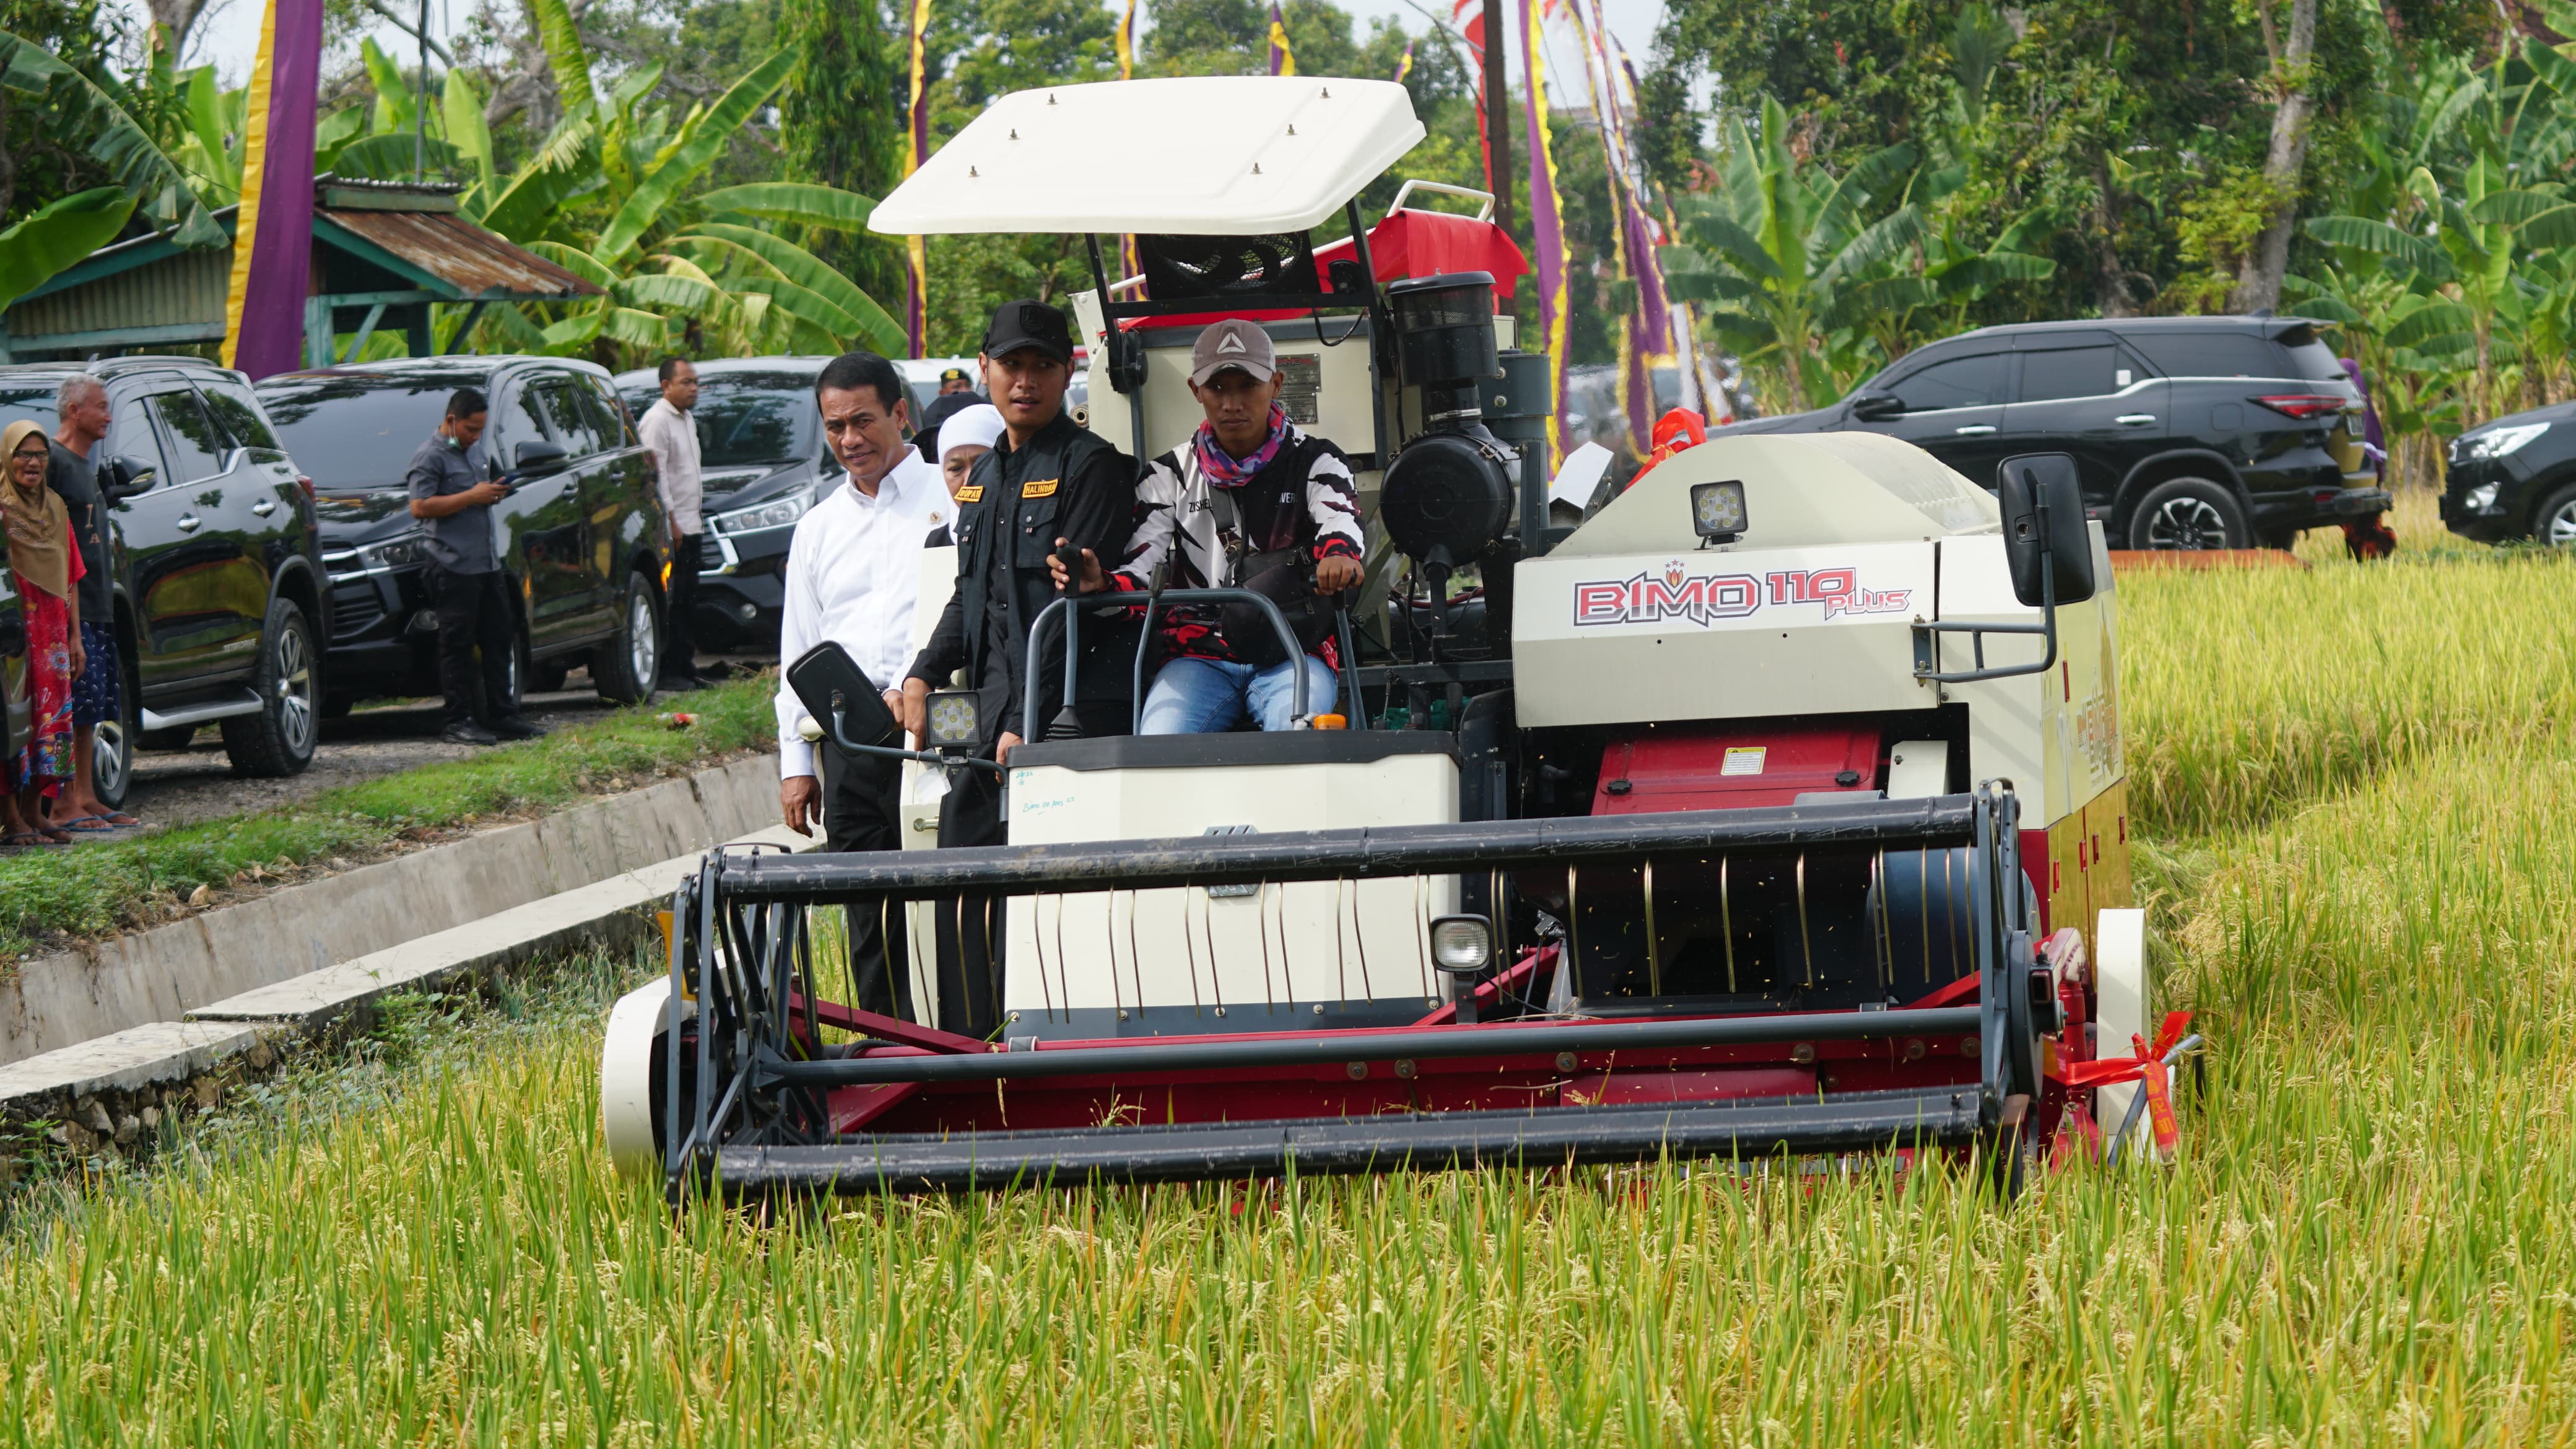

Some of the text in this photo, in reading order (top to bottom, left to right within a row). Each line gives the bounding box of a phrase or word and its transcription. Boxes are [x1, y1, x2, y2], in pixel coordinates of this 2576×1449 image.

[1574, 567, 1912, 627] BIMO 110 PLUS
